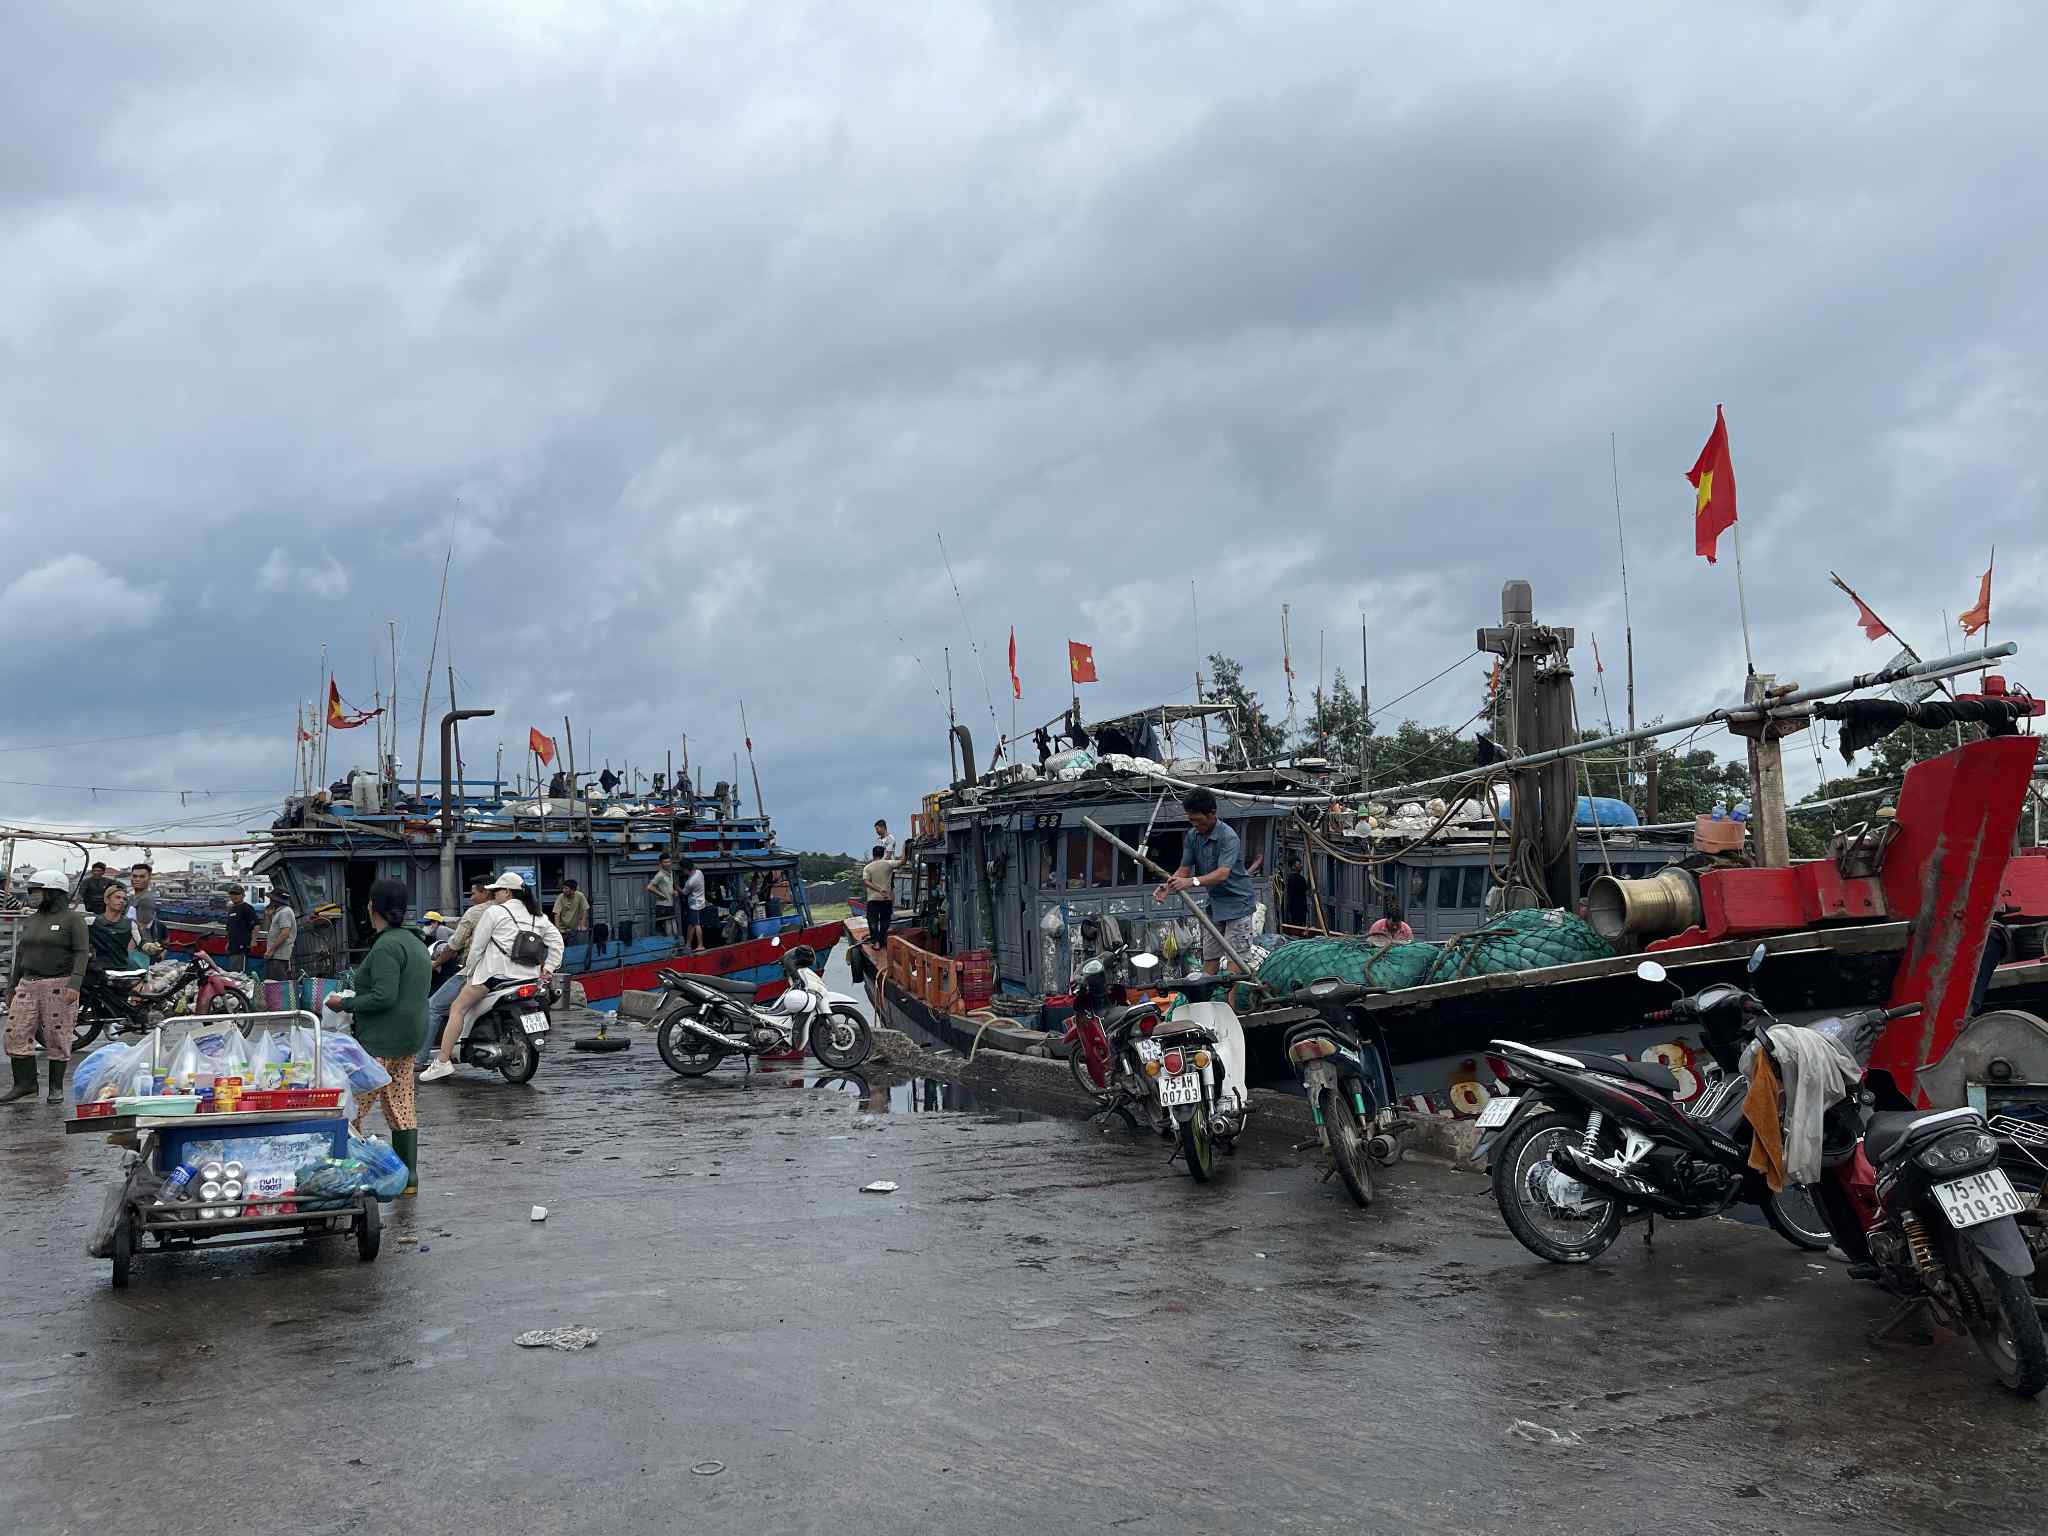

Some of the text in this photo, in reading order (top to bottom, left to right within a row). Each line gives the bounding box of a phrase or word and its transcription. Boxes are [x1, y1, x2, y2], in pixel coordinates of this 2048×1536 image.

[1711, 1139, 1739, 1156] HONDA
[259, 1177, 282, 1185] nutri
[259, 1183, 282, 1191] boost
[1943, 1173, 1999, 1202] 75-H1
[1949, 1192, 2019, 1225] 319.30
